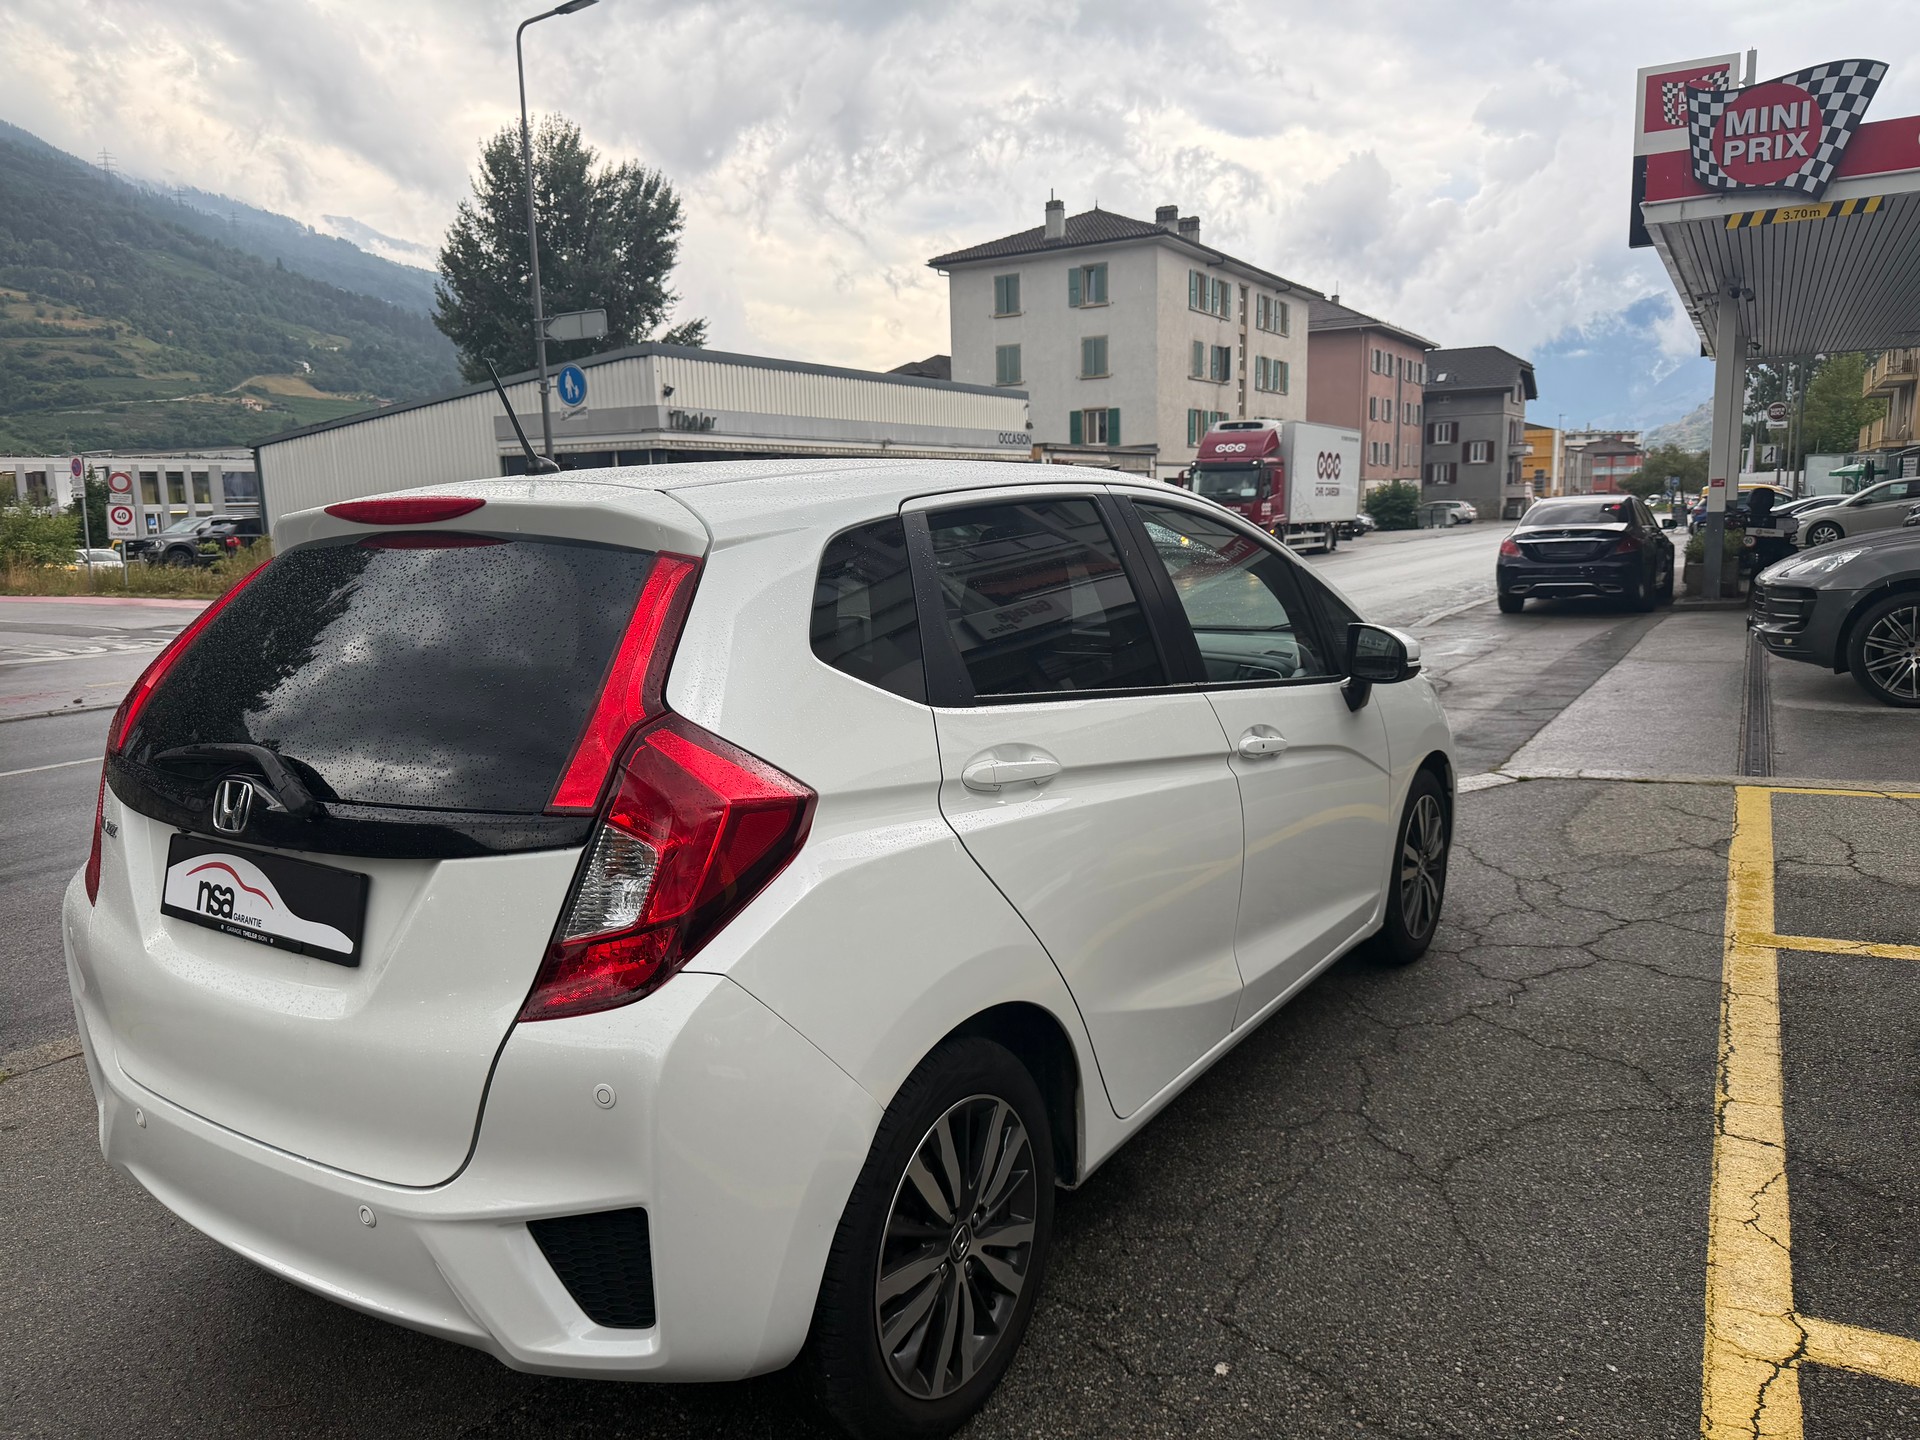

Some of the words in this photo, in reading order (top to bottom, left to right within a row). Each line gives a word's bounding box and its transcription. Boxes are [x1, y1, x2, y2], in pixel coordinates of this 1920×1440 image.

[1725, 100, 1811, 137] MINI
[1723, 131, 1810, 166] PRIX
[116, 511, 127, 520] 40
[196, 880, 235, 920] nsa
[226, 925, 242, 936] GARAGE
[233, 912, 263, 928] GARANTIE
